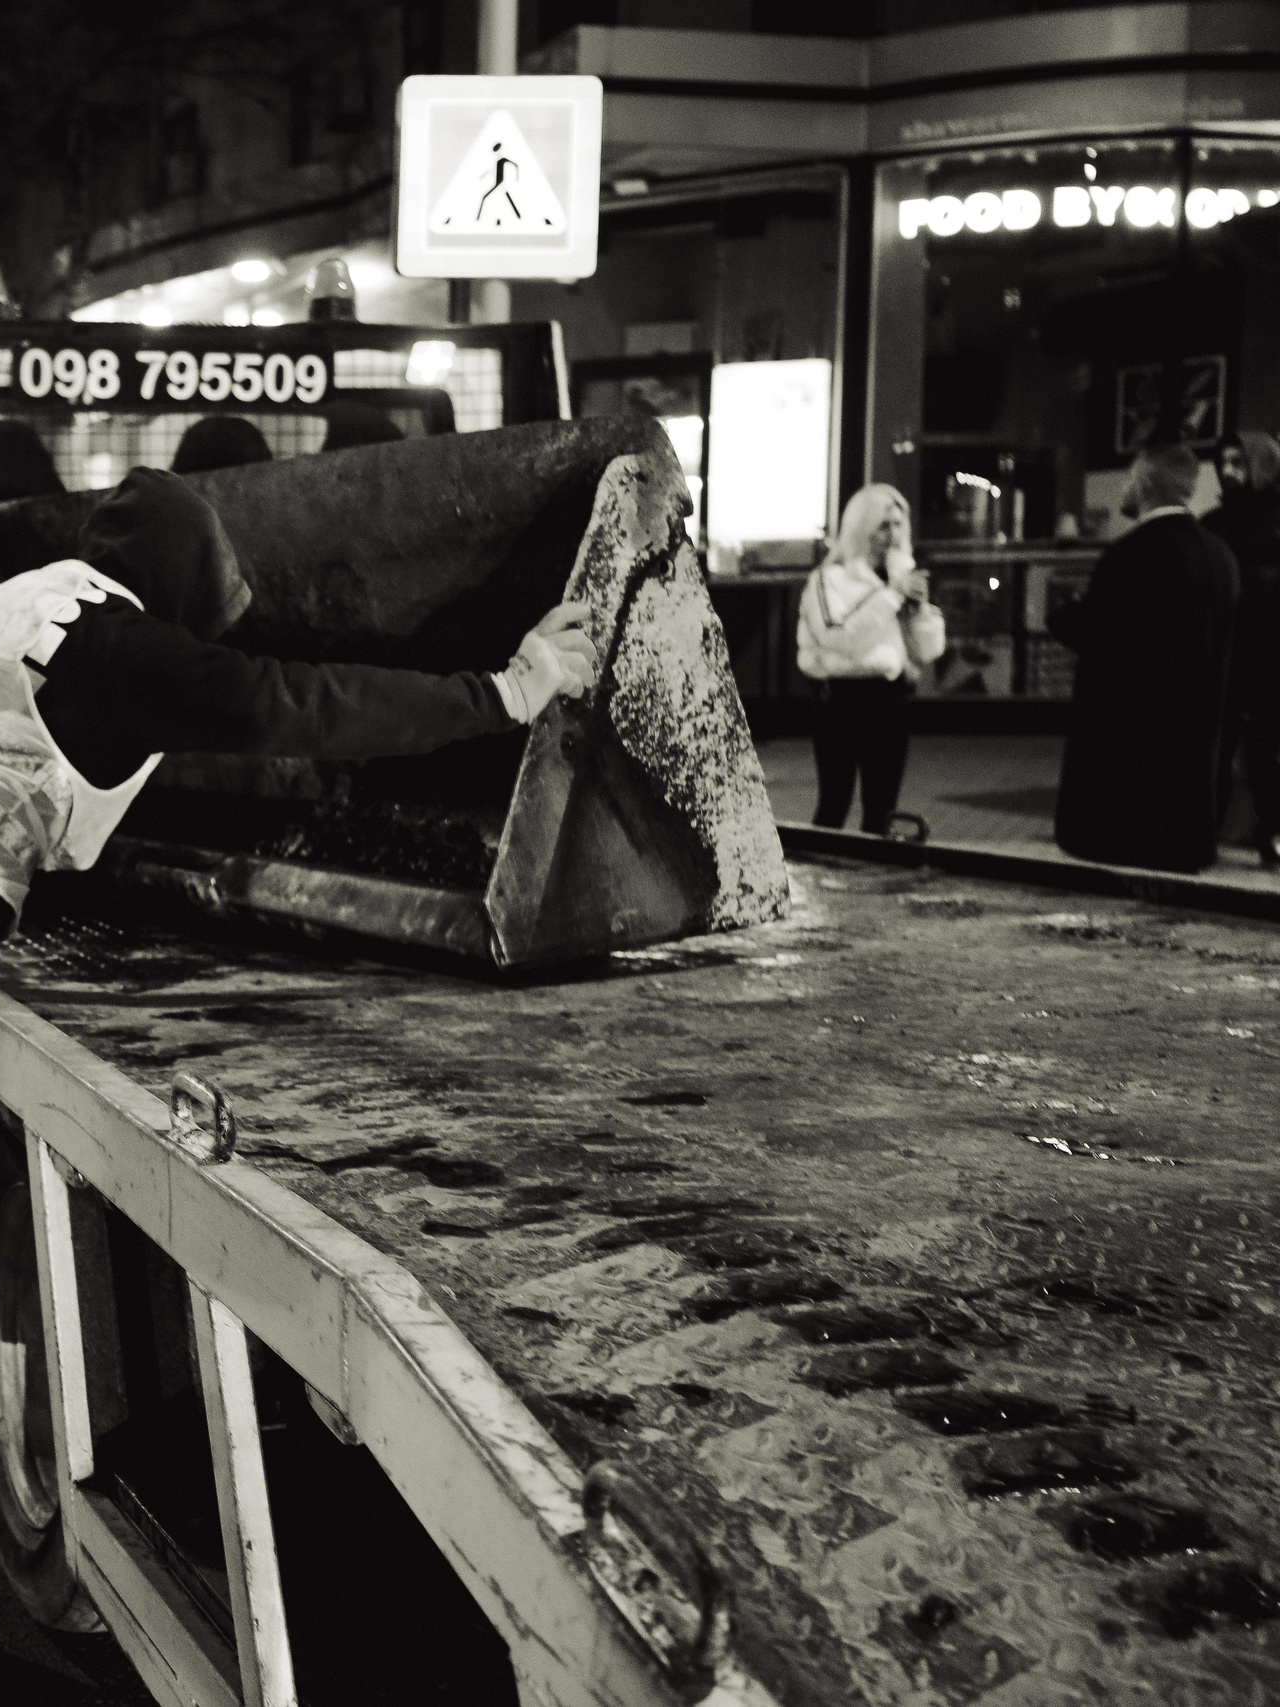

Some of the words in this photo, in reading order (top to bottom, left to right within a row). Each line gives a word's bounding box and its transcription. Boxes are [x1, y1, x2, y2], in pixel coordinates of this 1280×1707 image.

[899, 189, 1041, 238] FOOD
[20, 347, 121, 400] 098
[135, 350, 327, 404] 795509
